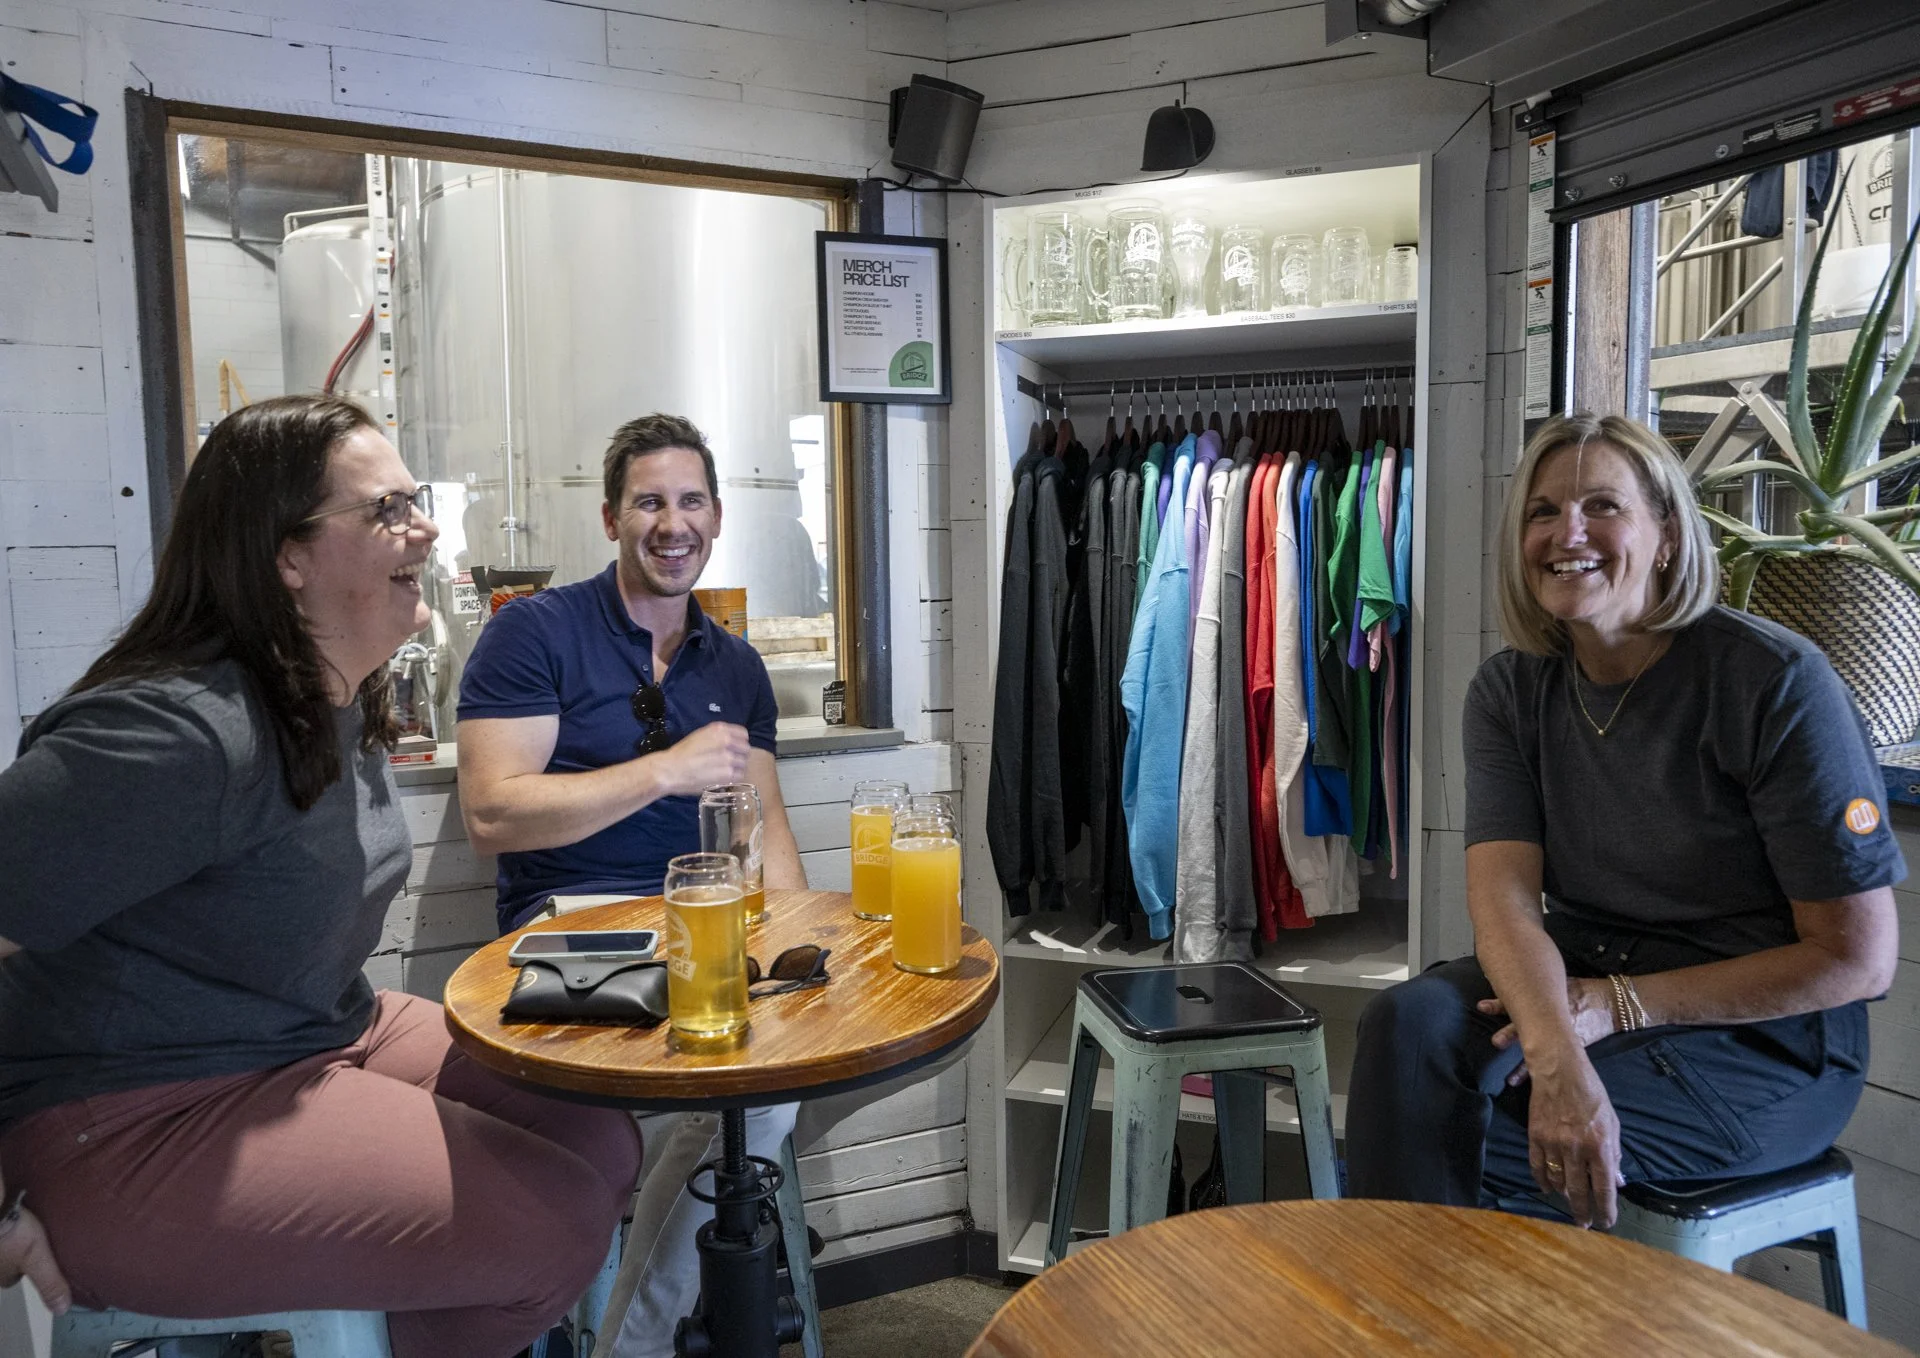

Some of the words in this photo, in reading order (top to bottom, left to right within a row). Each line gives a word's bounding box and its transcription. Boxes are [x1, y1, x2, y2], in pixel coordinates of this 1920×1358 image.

[1285, 167, 1313, 176] GLASSES
[1075, 190, 1091, 198] MUGS
[843, 258, 892, 274] MERCH
[843, 272, 881, 287] PRICE
[882, 274, 910, 288] LIST
[1383, 302, 1406, 311] SHIRTS
[1269, 313, 1285, 321] TEES
[999, 331, 1023, 339] HOODIES
[902, 371, 926, 381] BRIDGE
[855, 852, 890, 866] BRIDGE
[1181, 1112, 1196, 1120] HATS
